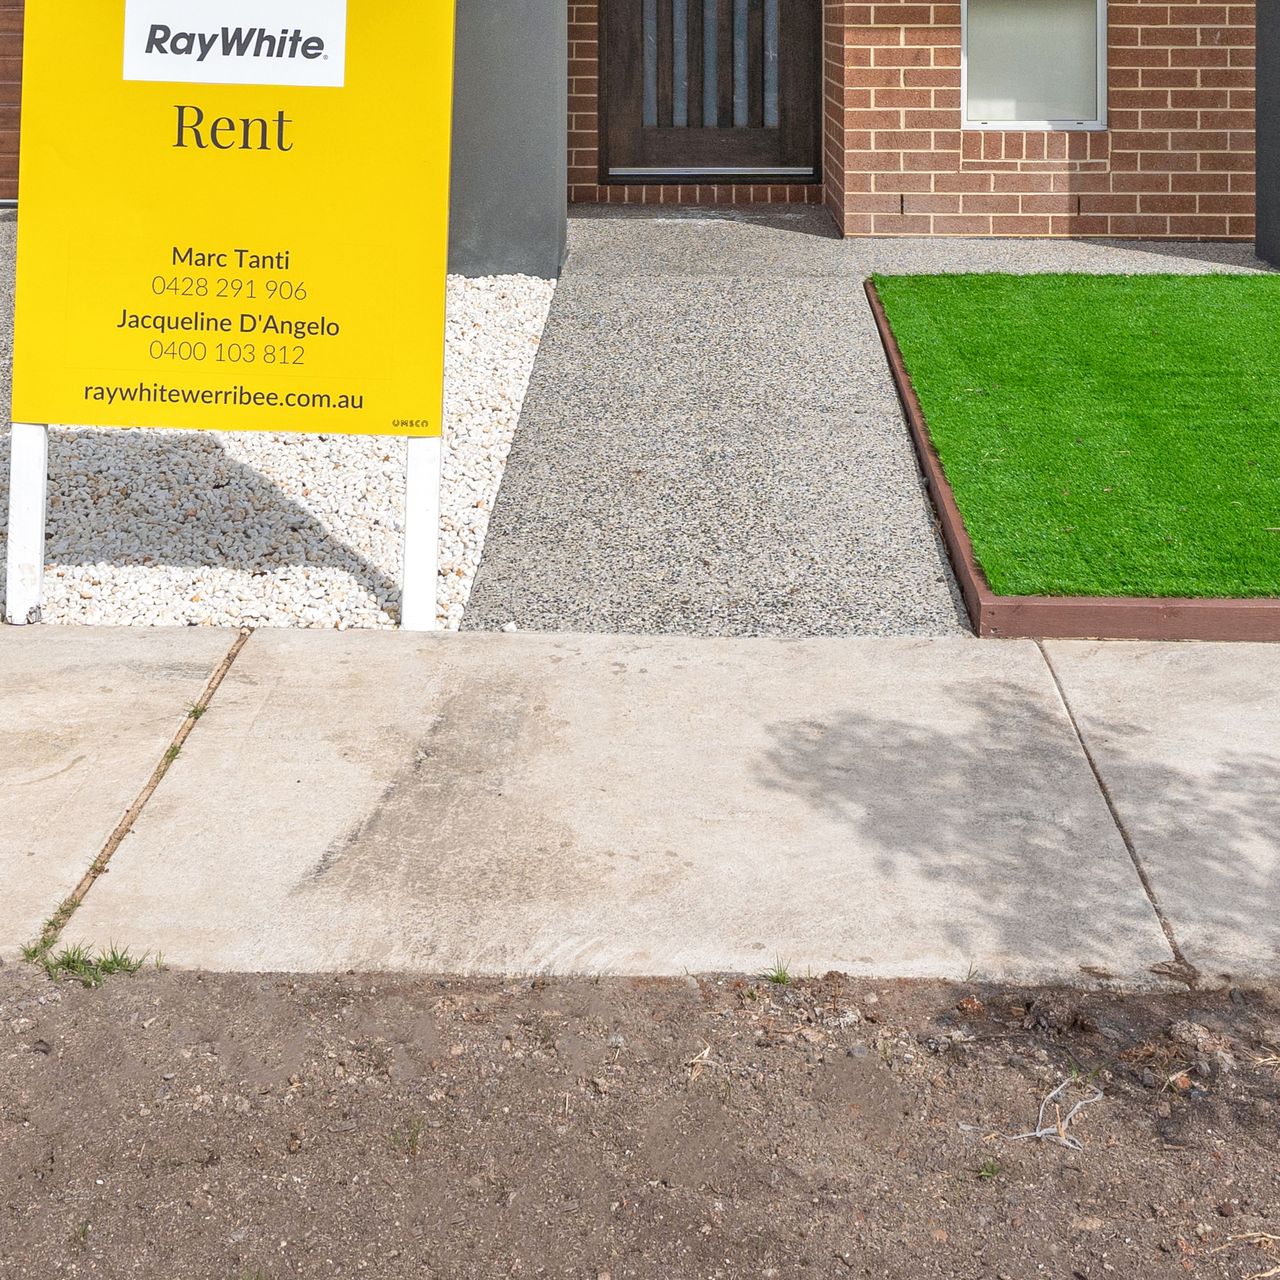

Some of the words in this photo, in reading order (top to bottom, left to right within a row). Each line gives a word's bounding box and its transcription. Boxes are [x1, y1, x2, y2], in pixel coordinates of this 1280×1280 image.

[172, 104, 294, 152] Rent
[172, 246, 228, 268] Marc
[234, 248, 290, 270] Tanti
[151, 275, 208, 297] 0428
[215, 278, 257, 299] 291
[265, 280, 307, 301] 906
[116, 309, 232, 334] Jacqueline
[239, 313, 340, 340] D'Angelo
[149, 340, 207, 361] 0400
[215, 343, 255, 363] 103
[263, 344, 305, 365] 812
[84, 382, 364, 409] raywhitewerribee.com.au
